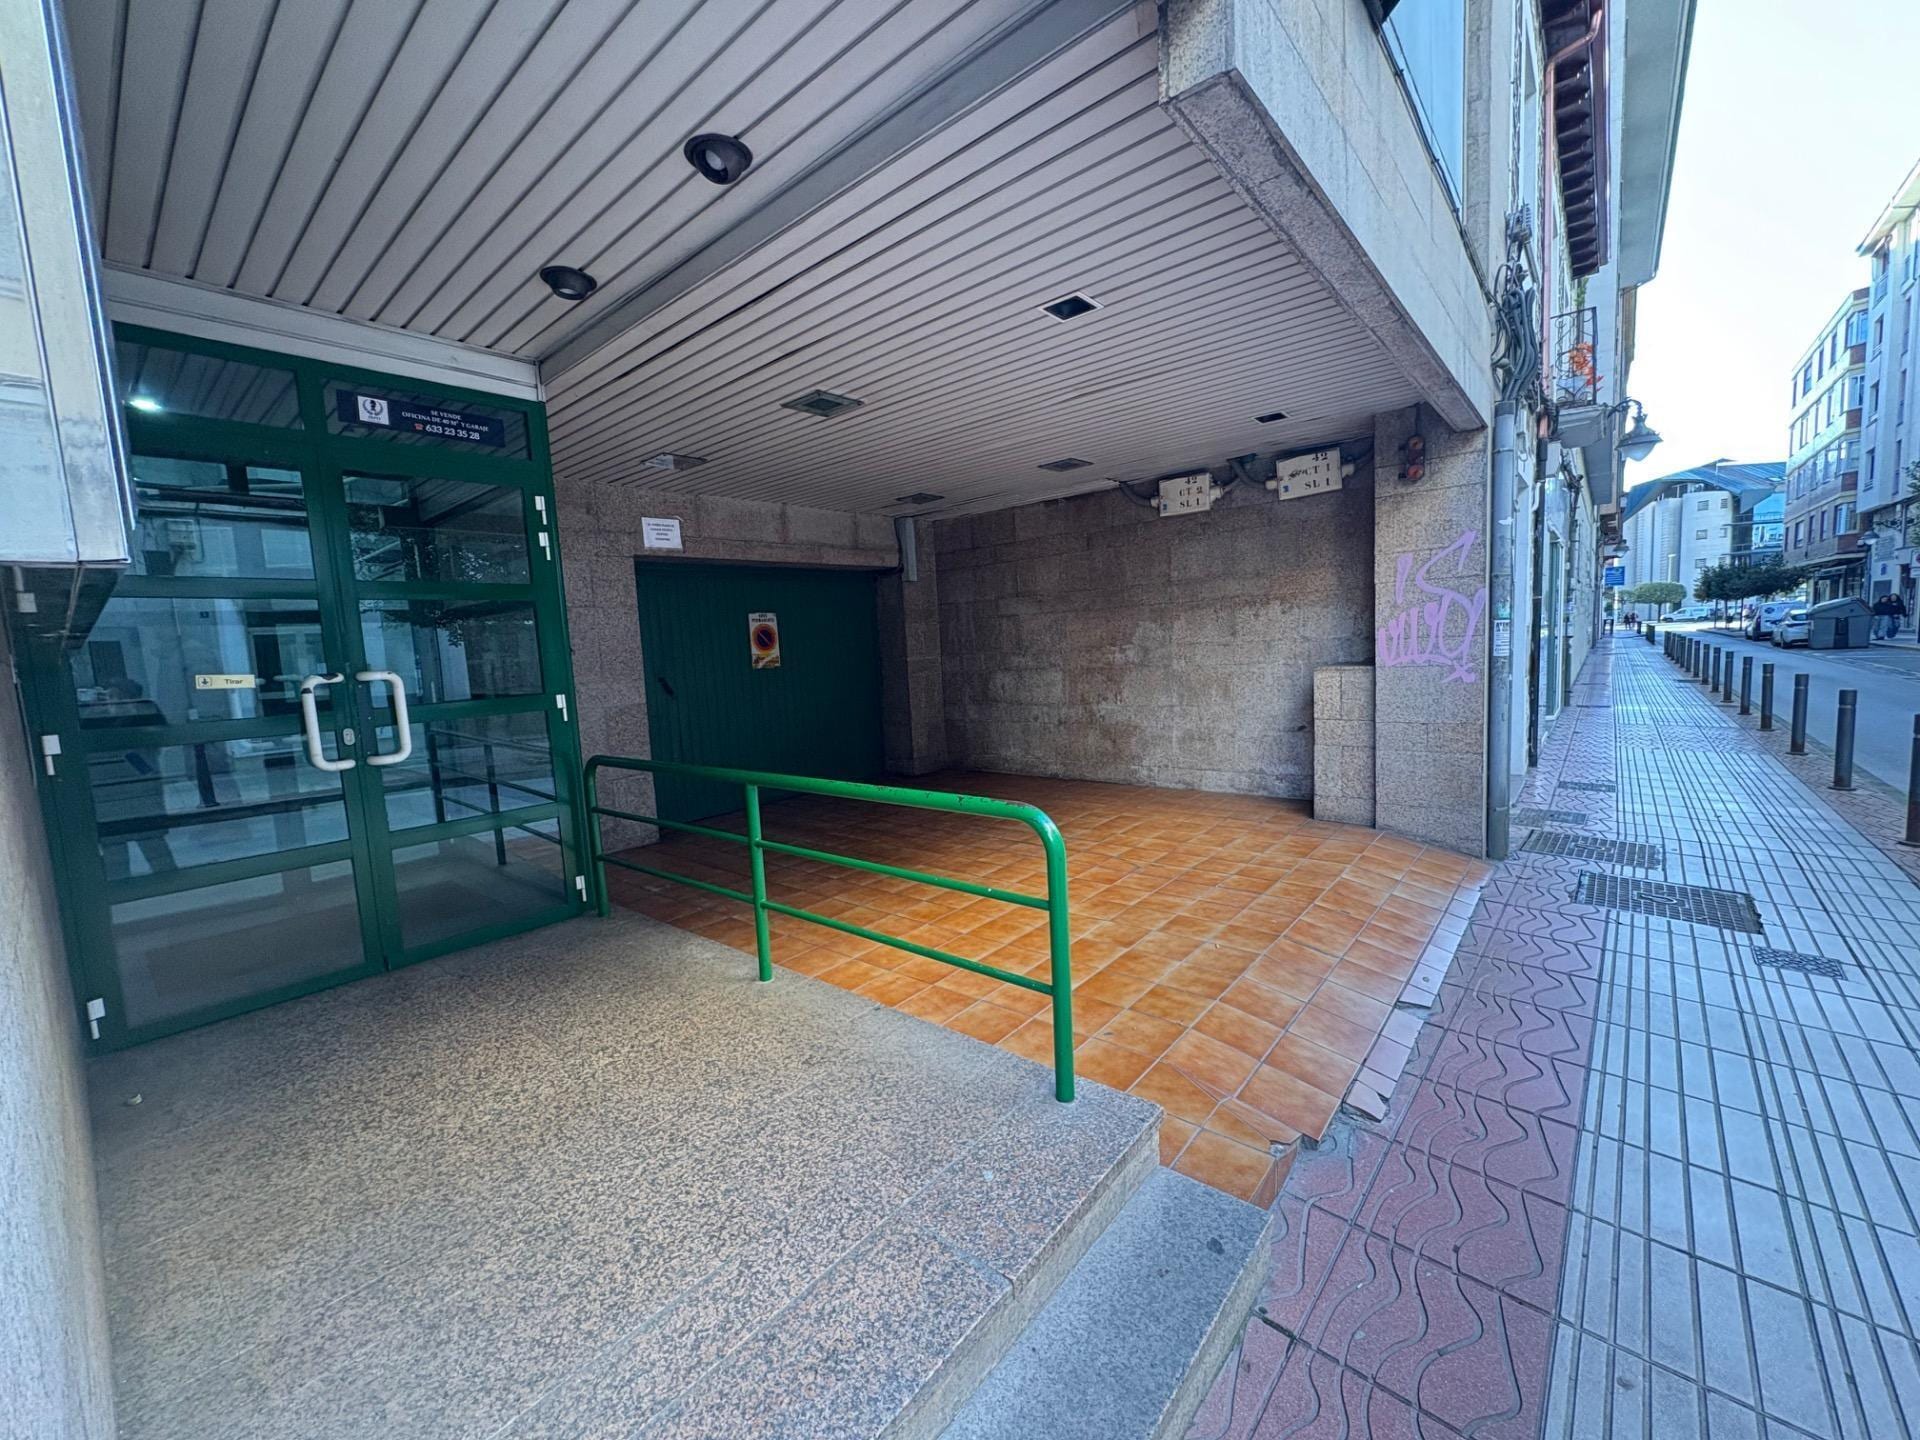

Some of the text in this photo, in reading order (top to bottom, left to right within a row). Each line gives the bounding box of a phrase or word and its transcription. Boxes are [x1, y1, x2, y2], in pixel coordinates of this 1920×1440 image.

[402, 412, 431, 421] OFICINA
[466, 423, 489, 432] GARAJE
[440, 412, 462, 420] VENDE
[425, 424, 480, 440] 633 23 35 28
